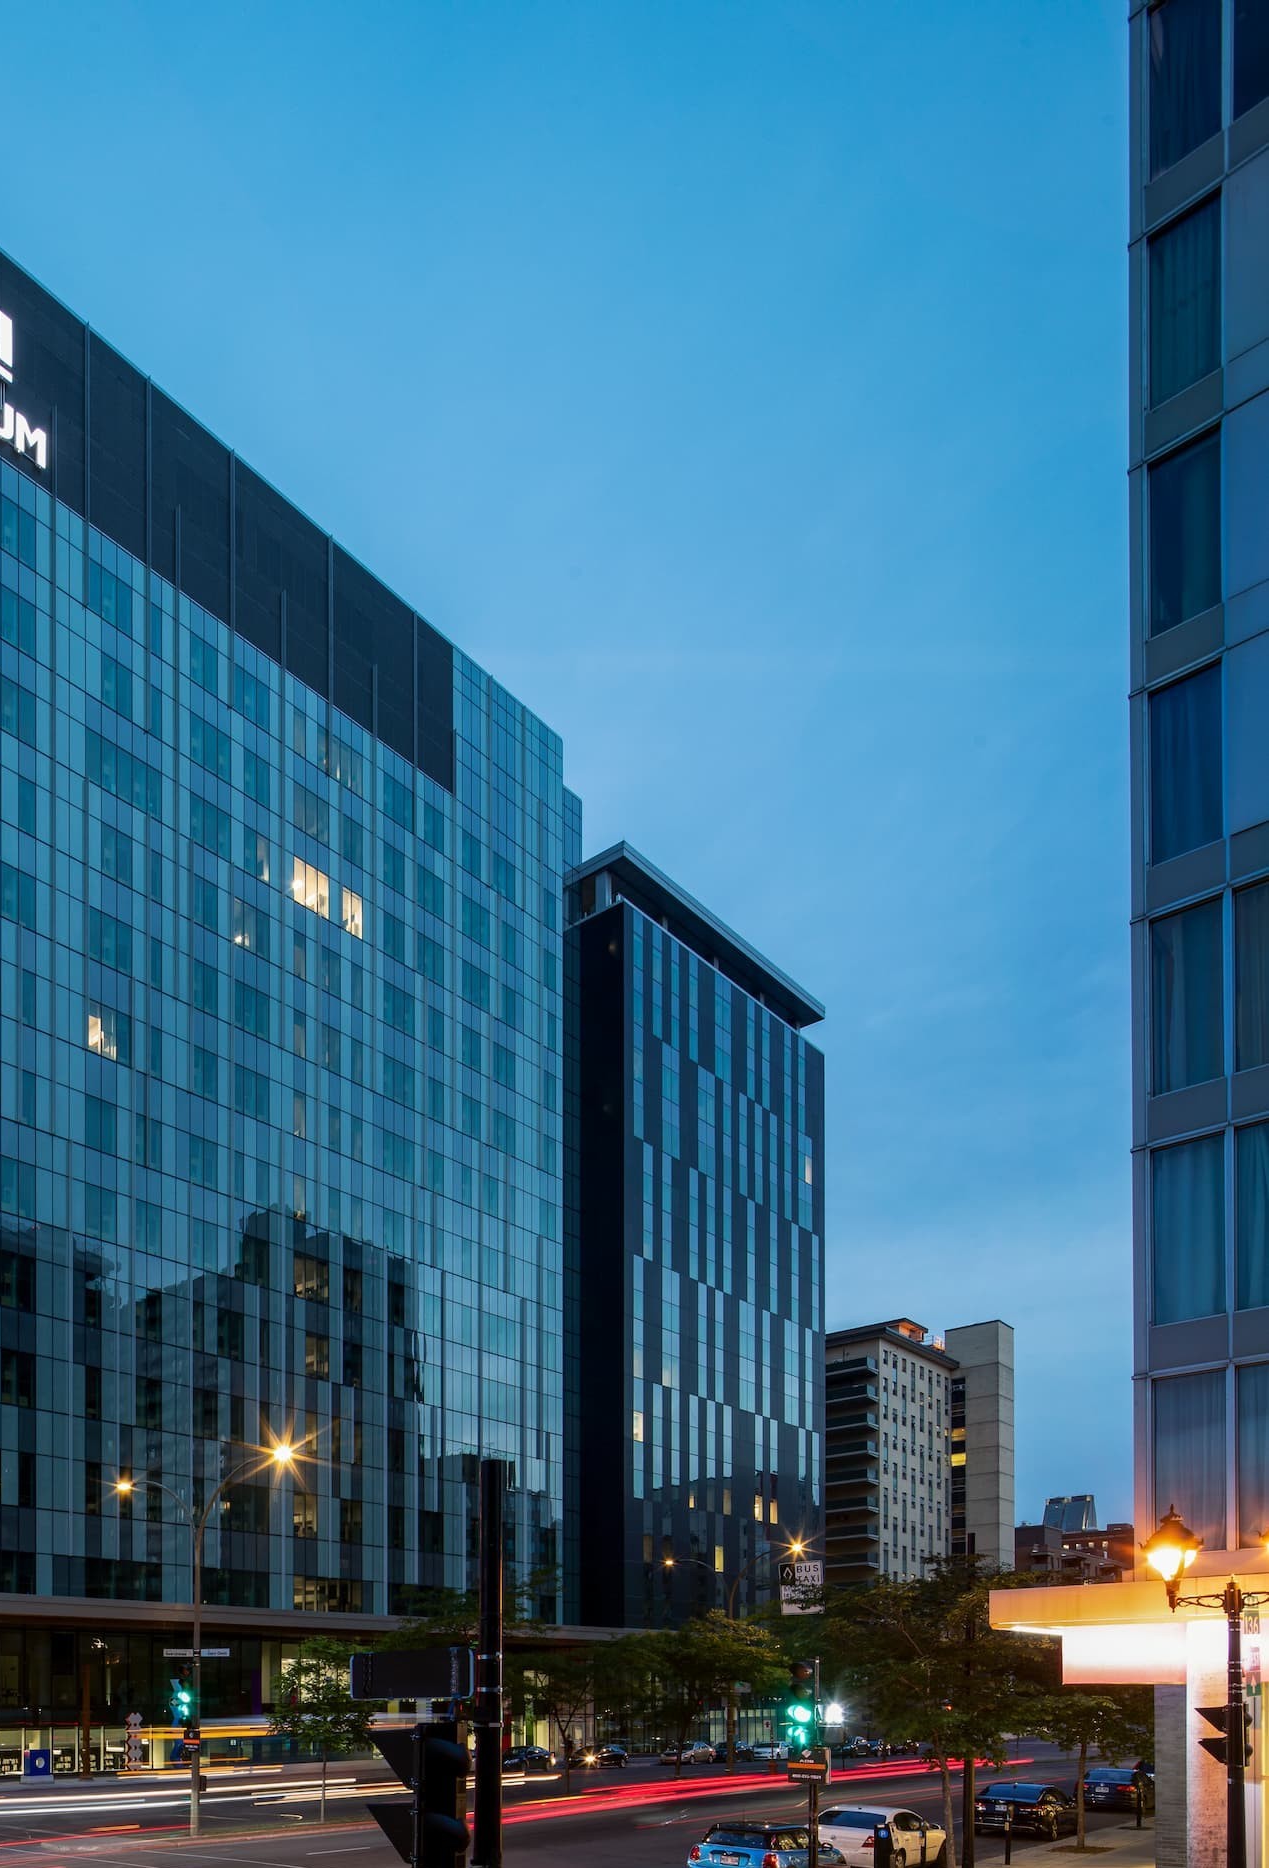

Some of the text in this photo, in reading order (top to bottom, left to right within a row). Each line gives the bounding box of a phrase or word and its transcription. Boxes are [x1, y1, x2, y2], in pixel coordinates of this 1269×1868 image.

[796, 1564, 819, 1574] BUS
[796, 1574, 820, 1583] TAXI
[1244, 1615, 1259, 1634] 136
